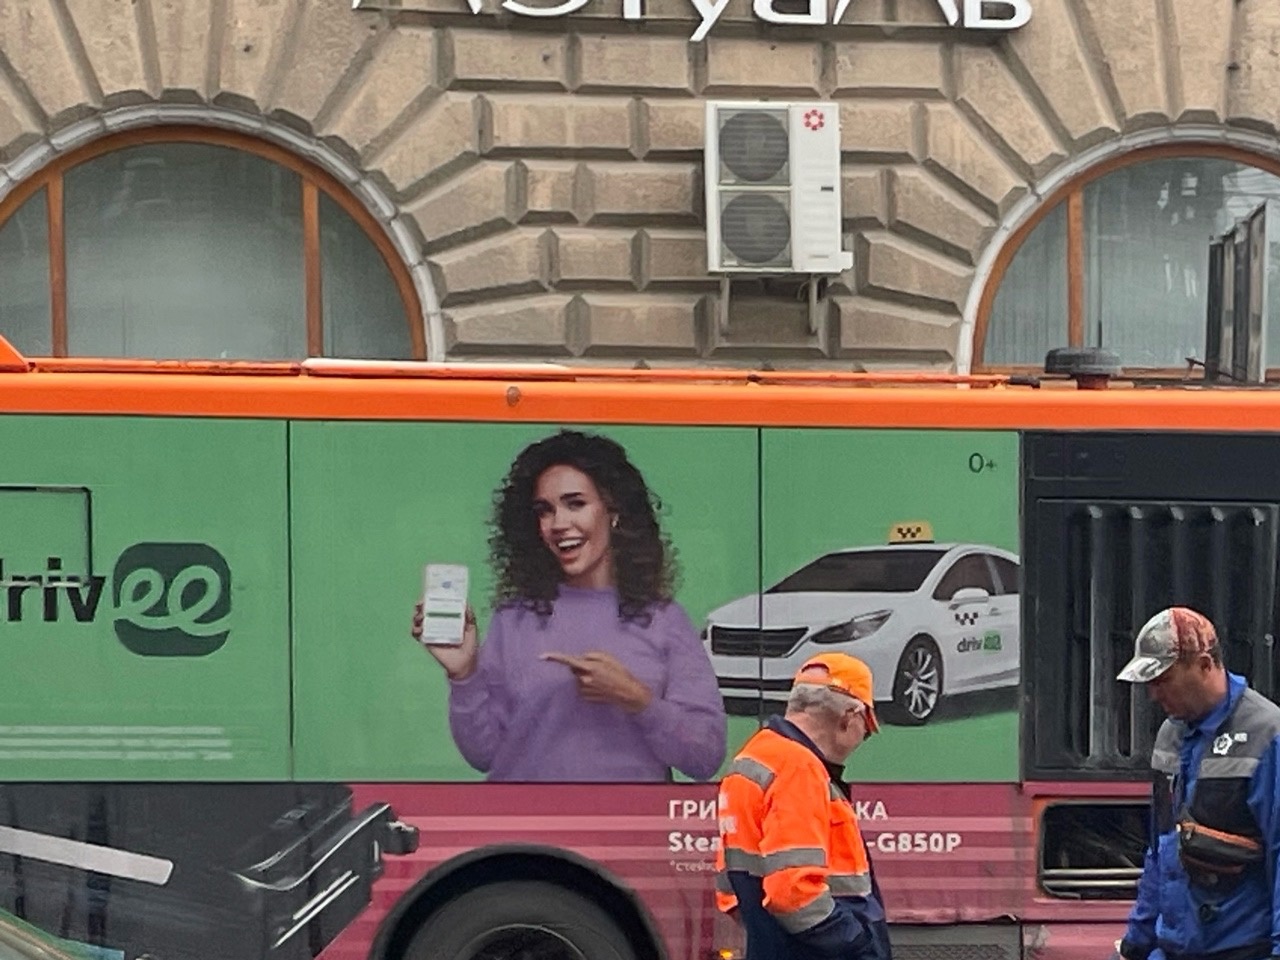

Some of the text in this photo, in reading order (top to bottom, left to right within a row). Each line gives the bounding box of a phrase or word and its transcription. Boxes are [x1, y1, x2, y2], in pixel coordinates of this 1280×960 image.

[968, 452, 998, 473] 0+
[668, 799, 718, 821] ГРИ
[855, 800, 889, 821] КА
[668, 831, 962, 853] Stea -G850P
